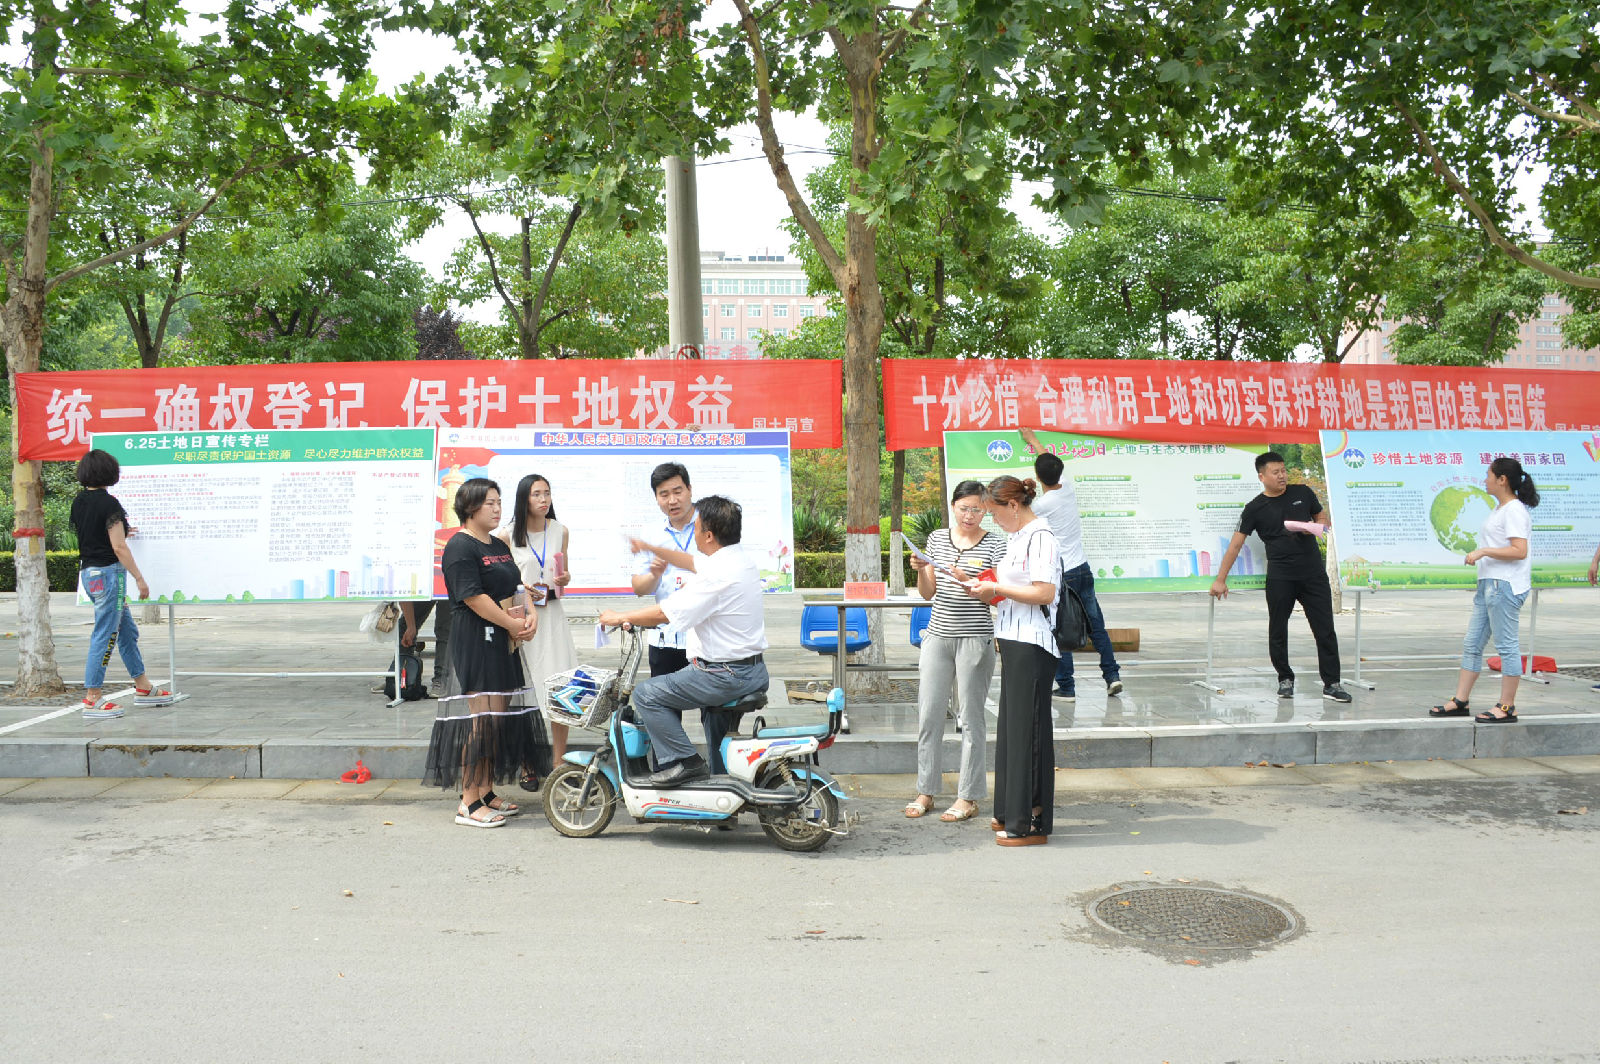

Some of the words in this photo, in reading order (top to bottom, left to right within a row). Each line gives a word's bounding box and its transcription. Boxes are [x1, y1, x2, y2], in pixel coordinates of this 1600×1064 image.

[46, 381, 368, 445] 统一确权登记
[400, 375, 736, 429] 保护土地权益
[912, 374, 1020, 431] 十分珍惜
[1033, 374, 1551, 431] 合理利用土地和切实保护耕地是我国的基本国策
[752, 417, 815, 433] 国土局宣
[124, 433, 270, 450] 6.25土地日宣传专栏
[541, 432, 747, 446] 中华人民共和国政府信息公开条例
[173, 449, 292, 462] 尽职尽责保护国土资源
[304, 447, 425, 460] 尽心尽力维护群众权益
[1112, 444, 1226, 455] 土地与生态文明建设
[1371, 452, 1464, 466] 珍惜土地资源
